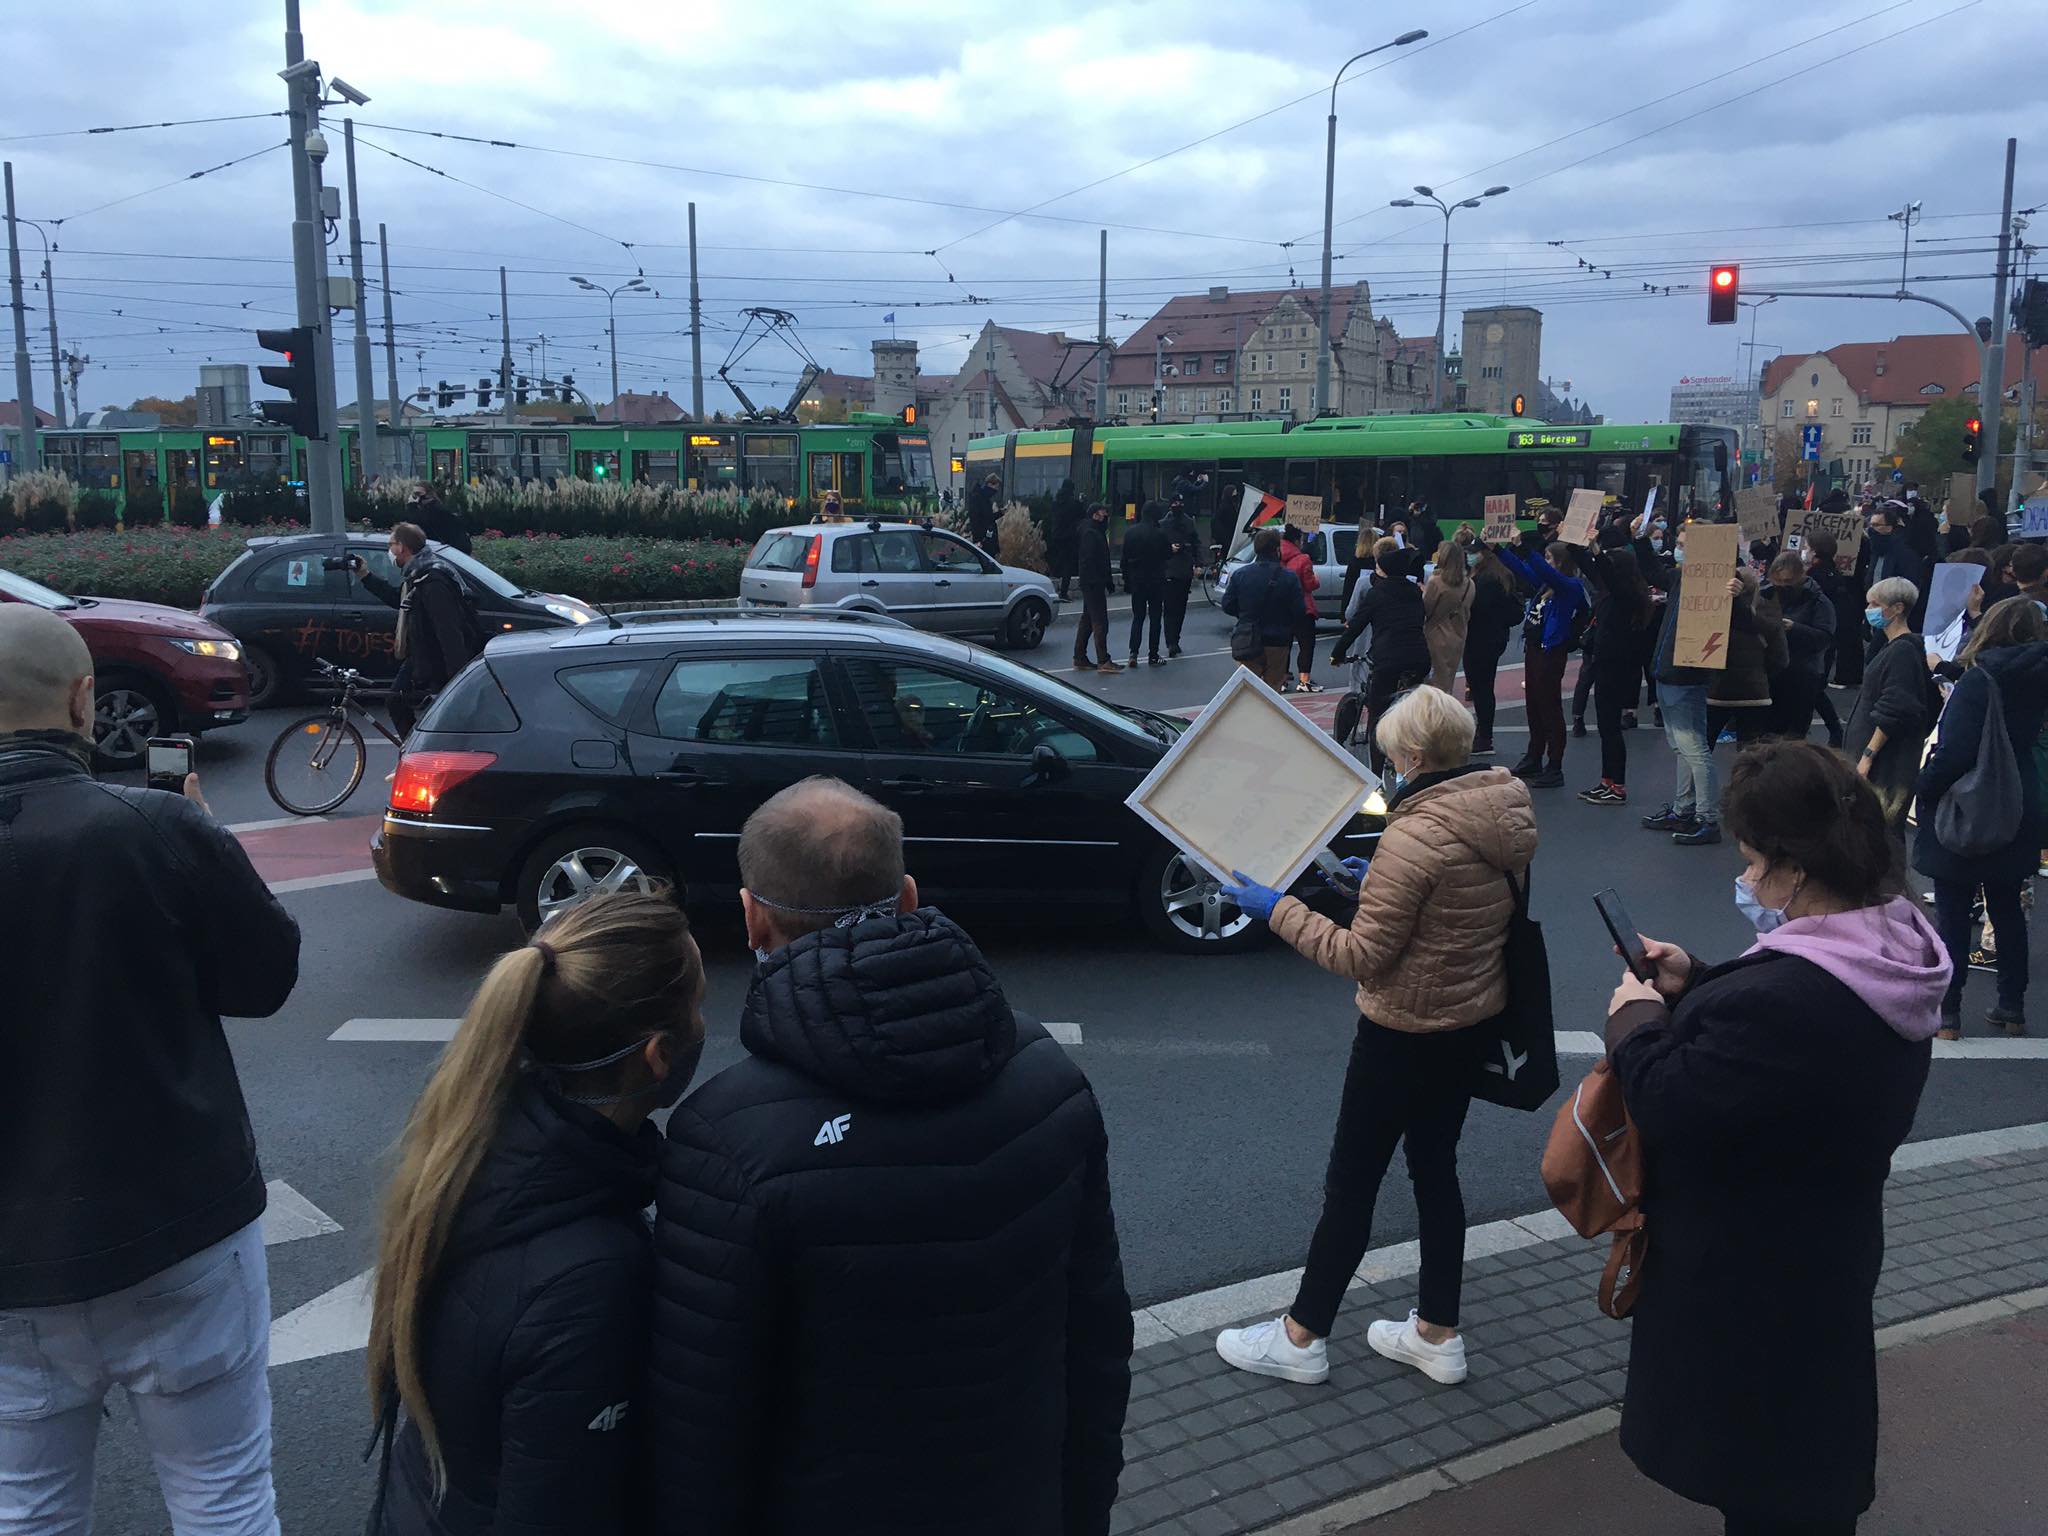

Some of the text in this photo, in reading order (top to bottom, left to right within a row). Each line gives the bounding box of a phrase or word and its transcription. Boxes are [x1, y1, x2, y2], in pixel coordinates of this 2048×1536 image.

[1690, 376, 1732, 384] Santander
[1516, 397, 1523, 413] 6
[905, 407, 916, 423] 10
[1518, 434, 1534, 446] 163
[1803, 513, 1861, 530] CHCEMY
